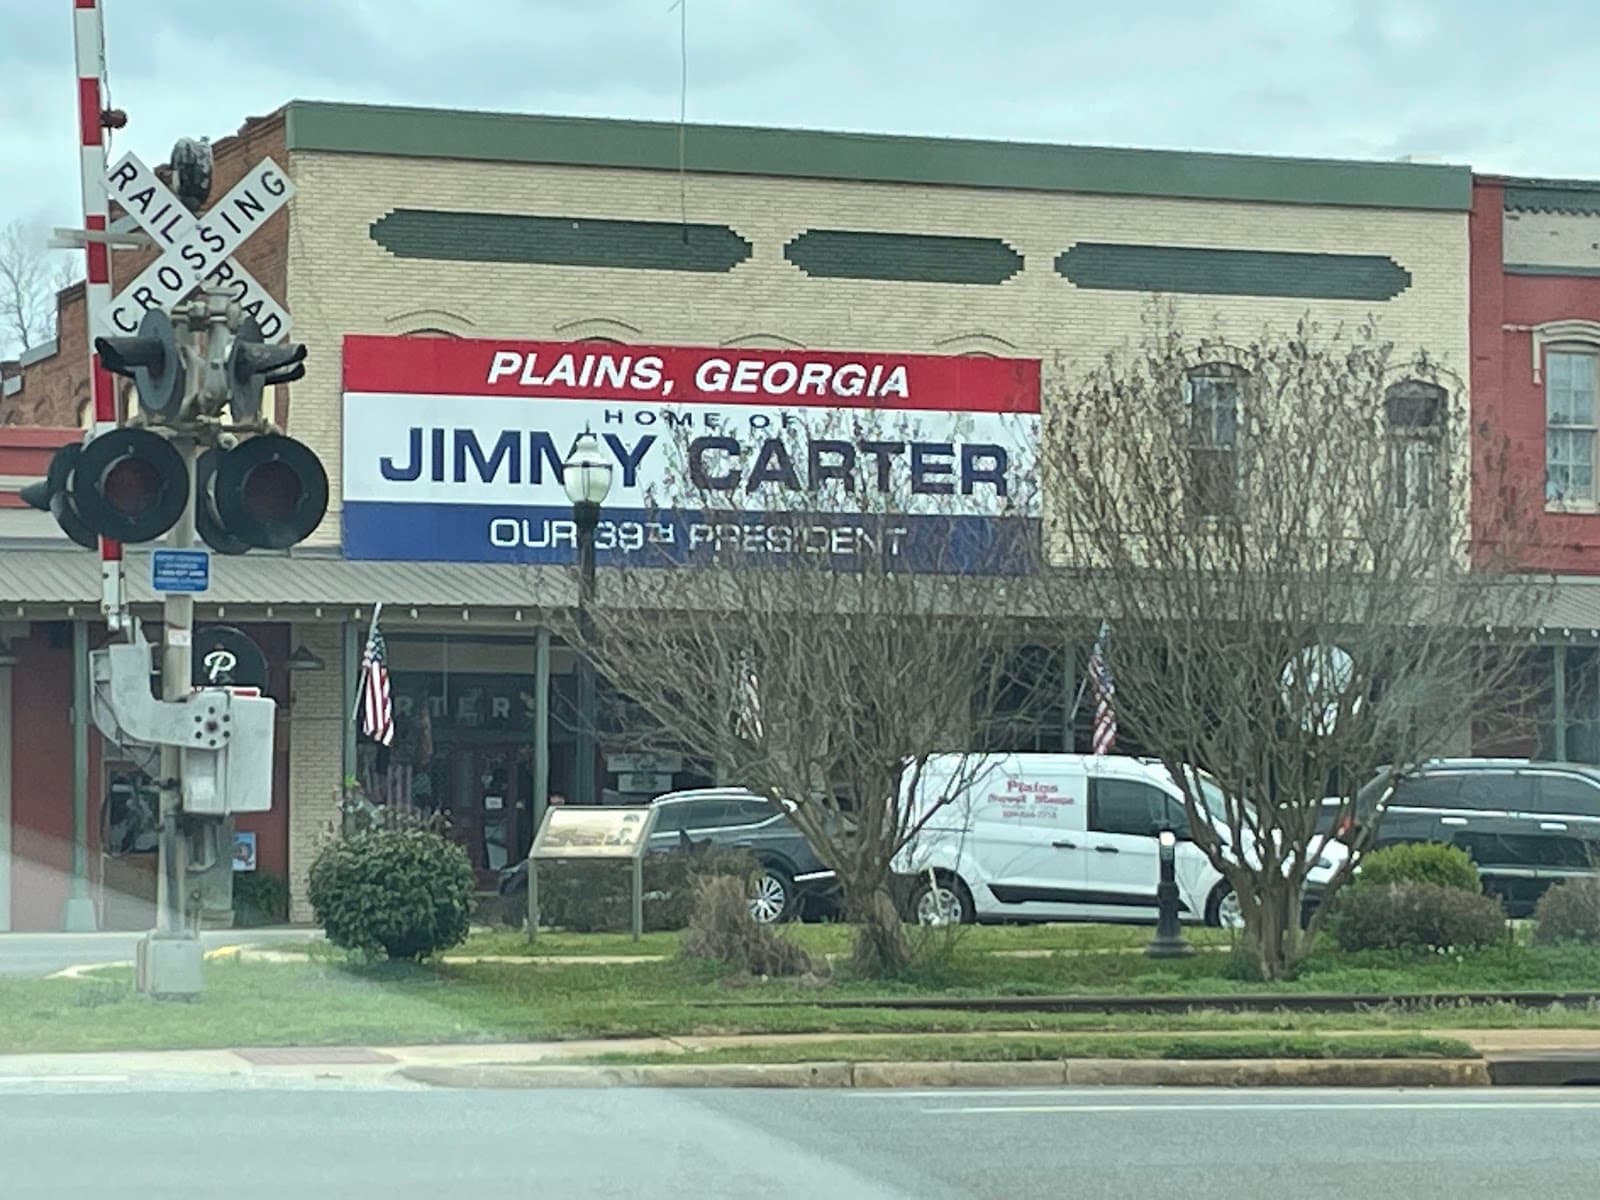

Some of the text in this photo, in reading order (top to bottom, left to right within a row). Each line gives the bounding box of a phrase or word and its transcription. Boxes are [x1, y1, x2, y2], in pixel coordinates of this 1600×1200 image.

[109, 161, 283, 340] RAIL ROAD
[112, 170, 286, 333] CROSSING
[488, 351, 910, 398] PLAINS, GEORGIA
[604, 408, 798, 430] HOME OF
[380, 427, 1009, 497] JIMMY CARTER
[490, 518, 577, 549] OUR
